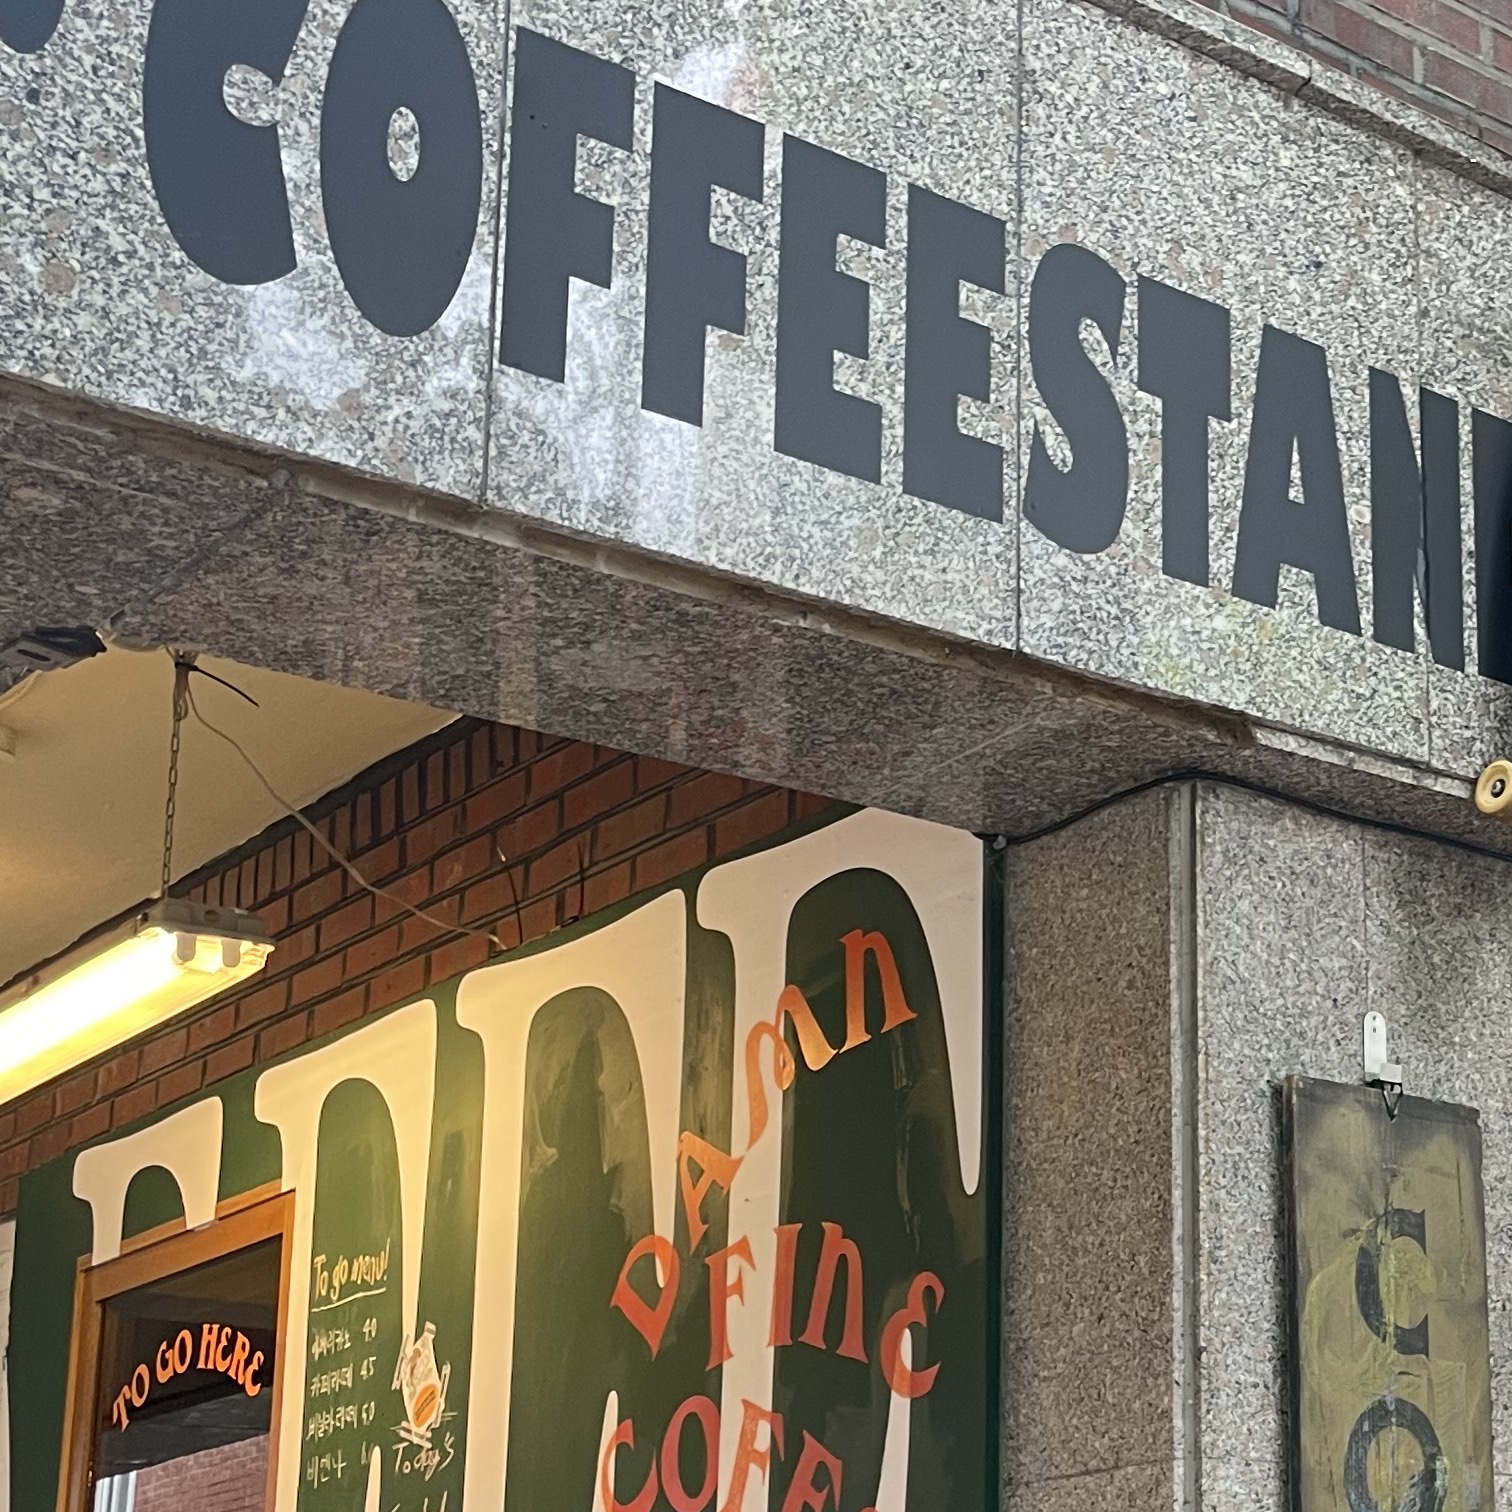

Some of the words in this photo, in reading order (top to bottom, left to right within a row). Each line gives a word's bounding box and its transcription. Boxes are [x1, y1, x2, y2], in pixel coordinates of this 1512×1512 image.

[330, 1254, 349, 1303] go
[112, 1363, 150, 1433] TO
[156, 1329, 193, 1384] GO
[196, 1323, 265, 1397] HERE
